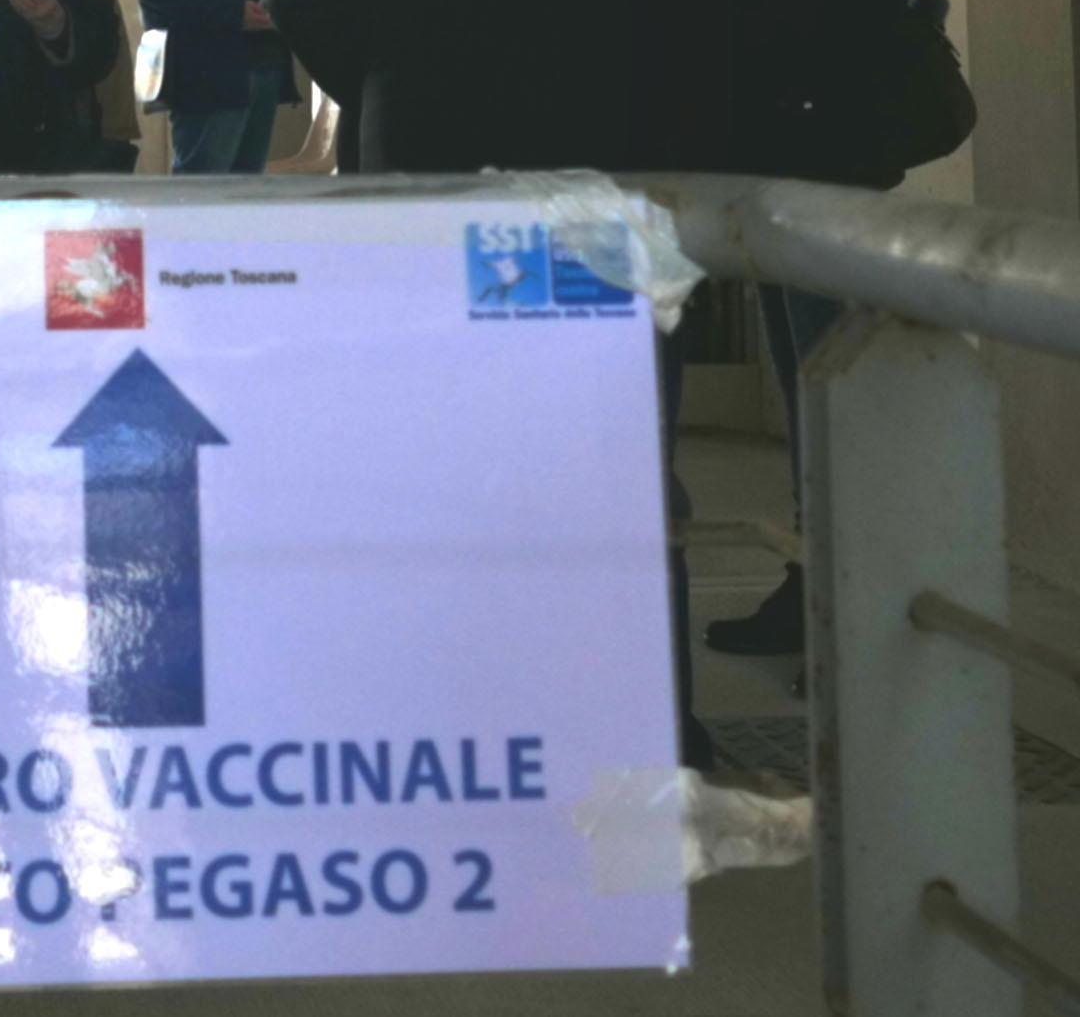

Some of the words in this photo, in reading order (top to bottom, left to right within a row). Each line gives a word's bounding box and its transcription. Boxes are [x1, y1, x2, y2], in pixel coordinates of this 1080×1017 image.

[158, 268, 224, 289] Regione
[230, 268, 297, 284] Toscana
[95, 736, 547, 810] VACCINALE
[452, 849, 496, 912] 2
